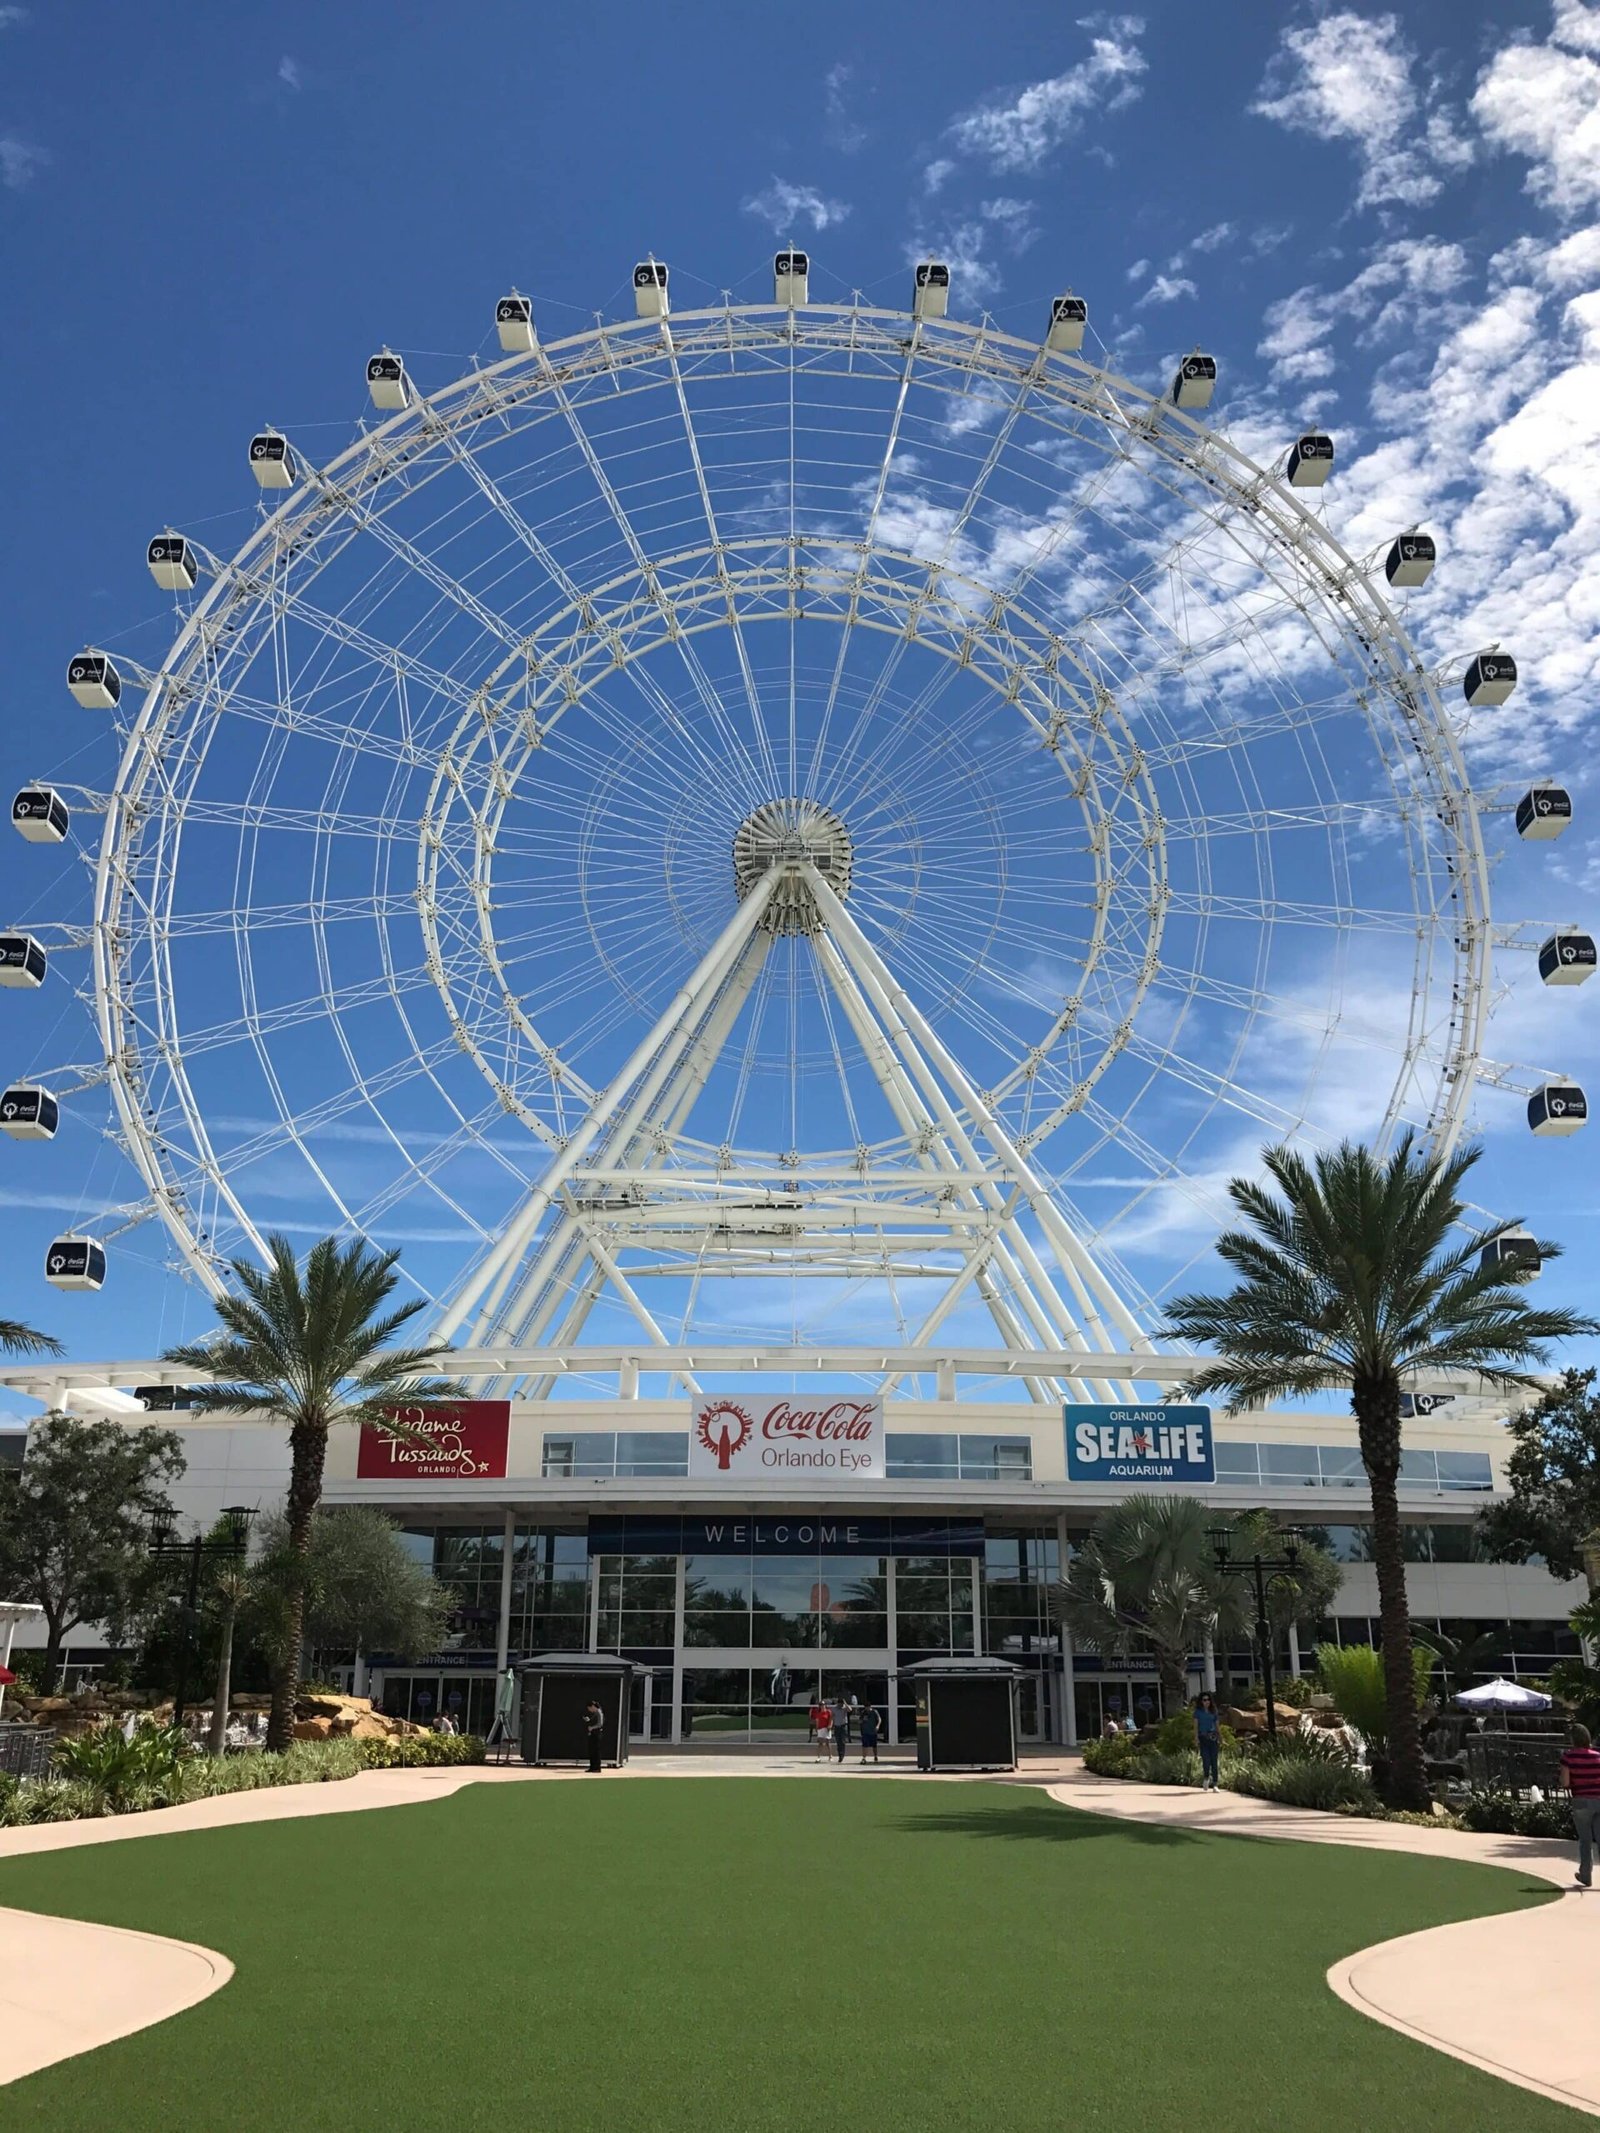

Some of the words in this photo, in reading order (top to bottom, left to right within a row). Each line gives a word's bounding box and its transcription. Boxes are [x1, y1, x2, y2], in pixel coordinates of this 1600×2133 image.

[762, 1402, 879, 1441] Coca-Cola
[1109, 1411, 1166, 1421] ORLANDO
[378, 1434, 476, 1475] Tussauds
[761, 1448, 836, 1467] Orlando
[840, 1448, 872, 1471] Eye
[1109, 1465, 1173, 1476] AQUARIUM
[705, 1526, 860, 1543] WELCOME
